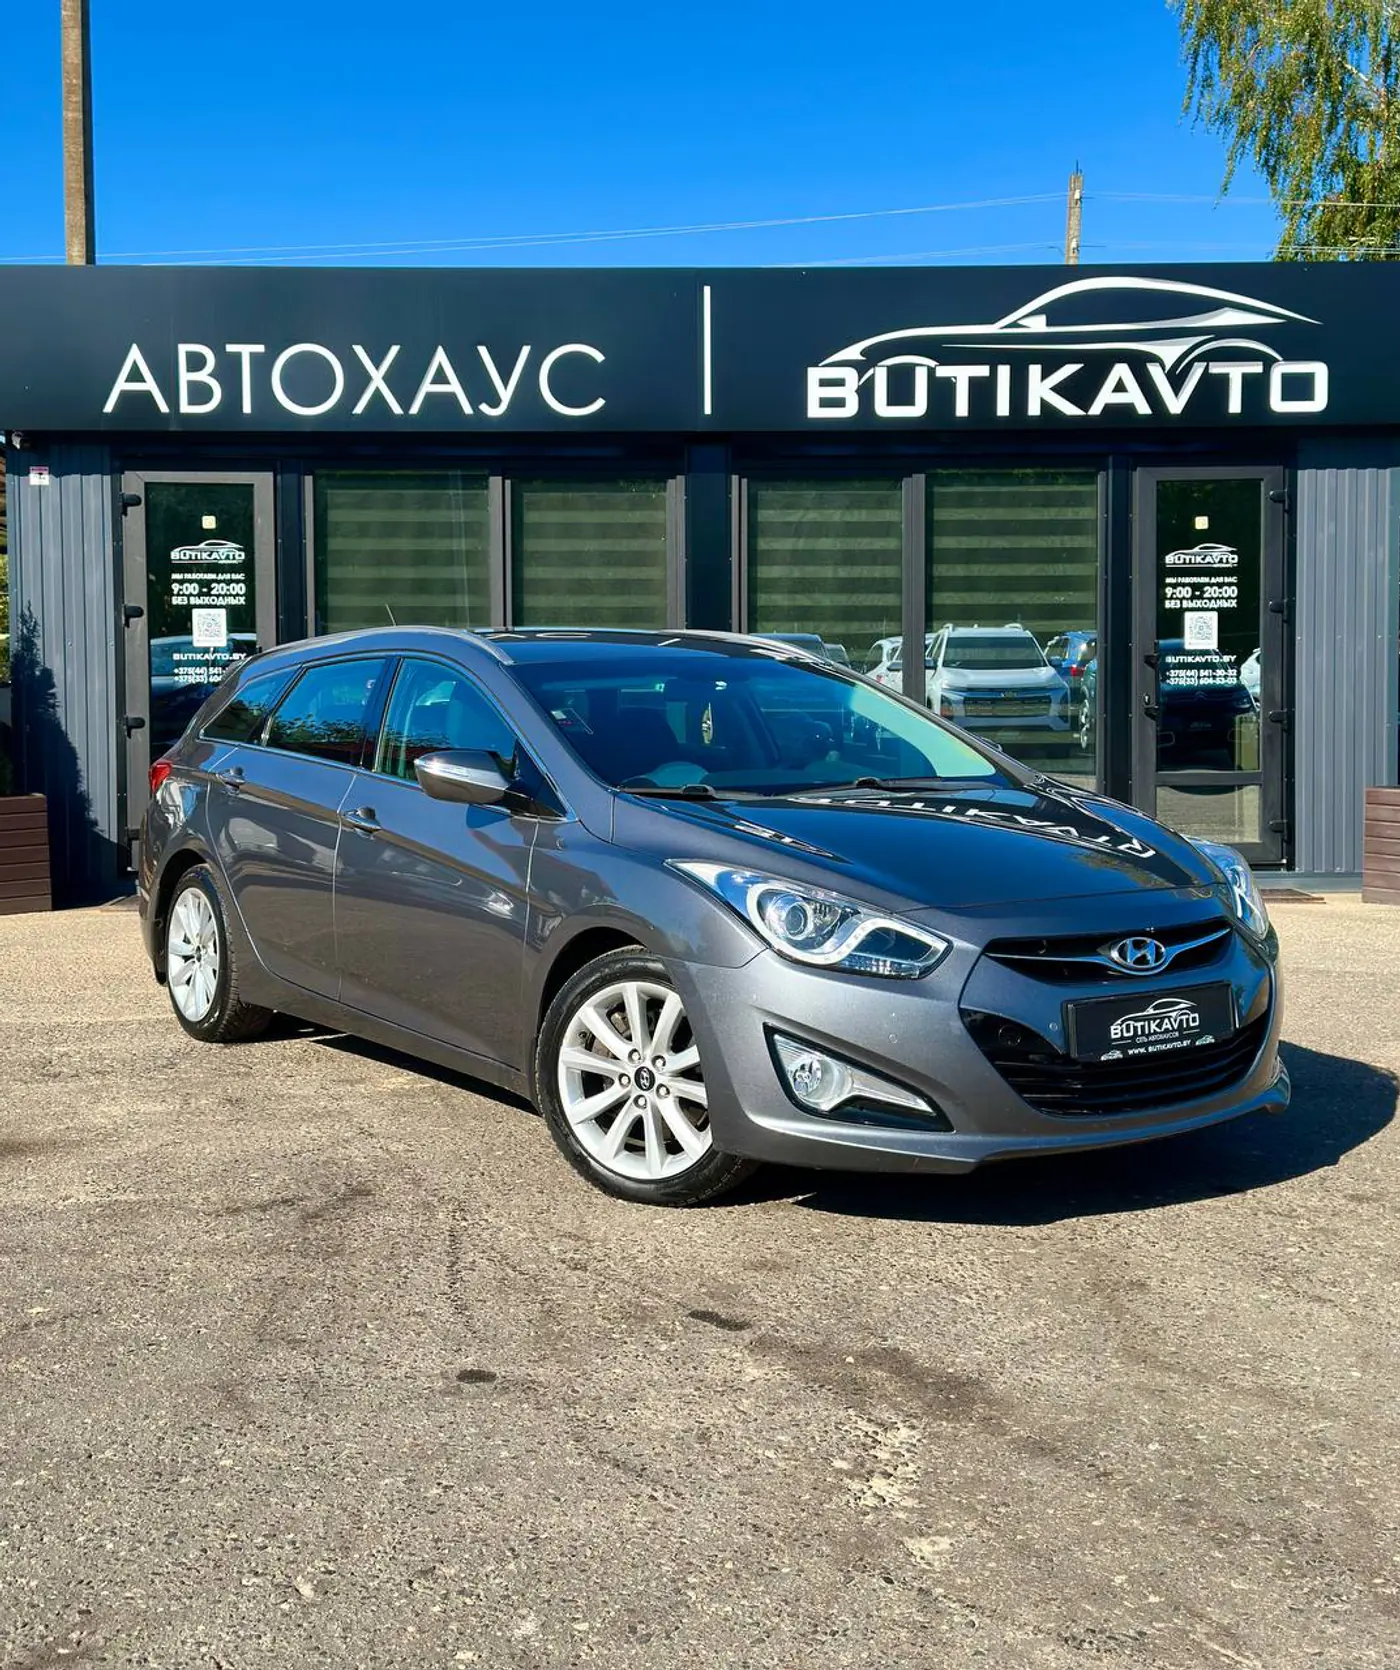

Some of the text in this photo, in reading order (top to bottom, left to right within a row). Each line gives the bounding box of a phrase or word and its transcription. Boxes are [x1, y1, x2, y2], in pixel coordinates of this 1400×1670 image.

[102, 343, 606, 416] АВТОХАУС
[806, 361, 1329, 419] BUTIKAVTO
[170, 550, 245, 560] BUTIKAVTO
[1165, 554, 1239, 564] BUTIKAVTO
[171, 582, 199, 595] 9:00
[210, 582, 246, 595] 20:00
[1165, 586, 1192, 598] 9:00
[1203, 586, 1238, 598] 20:00
[171, 596, 246, 606] БЕЗ ВЫХОДНЫХ
[1165, 599, 1237, 609] БЕЗ ВЫХОДНЫХ
[1110, 1013, 1200, 1039] BUTIKAVTO
